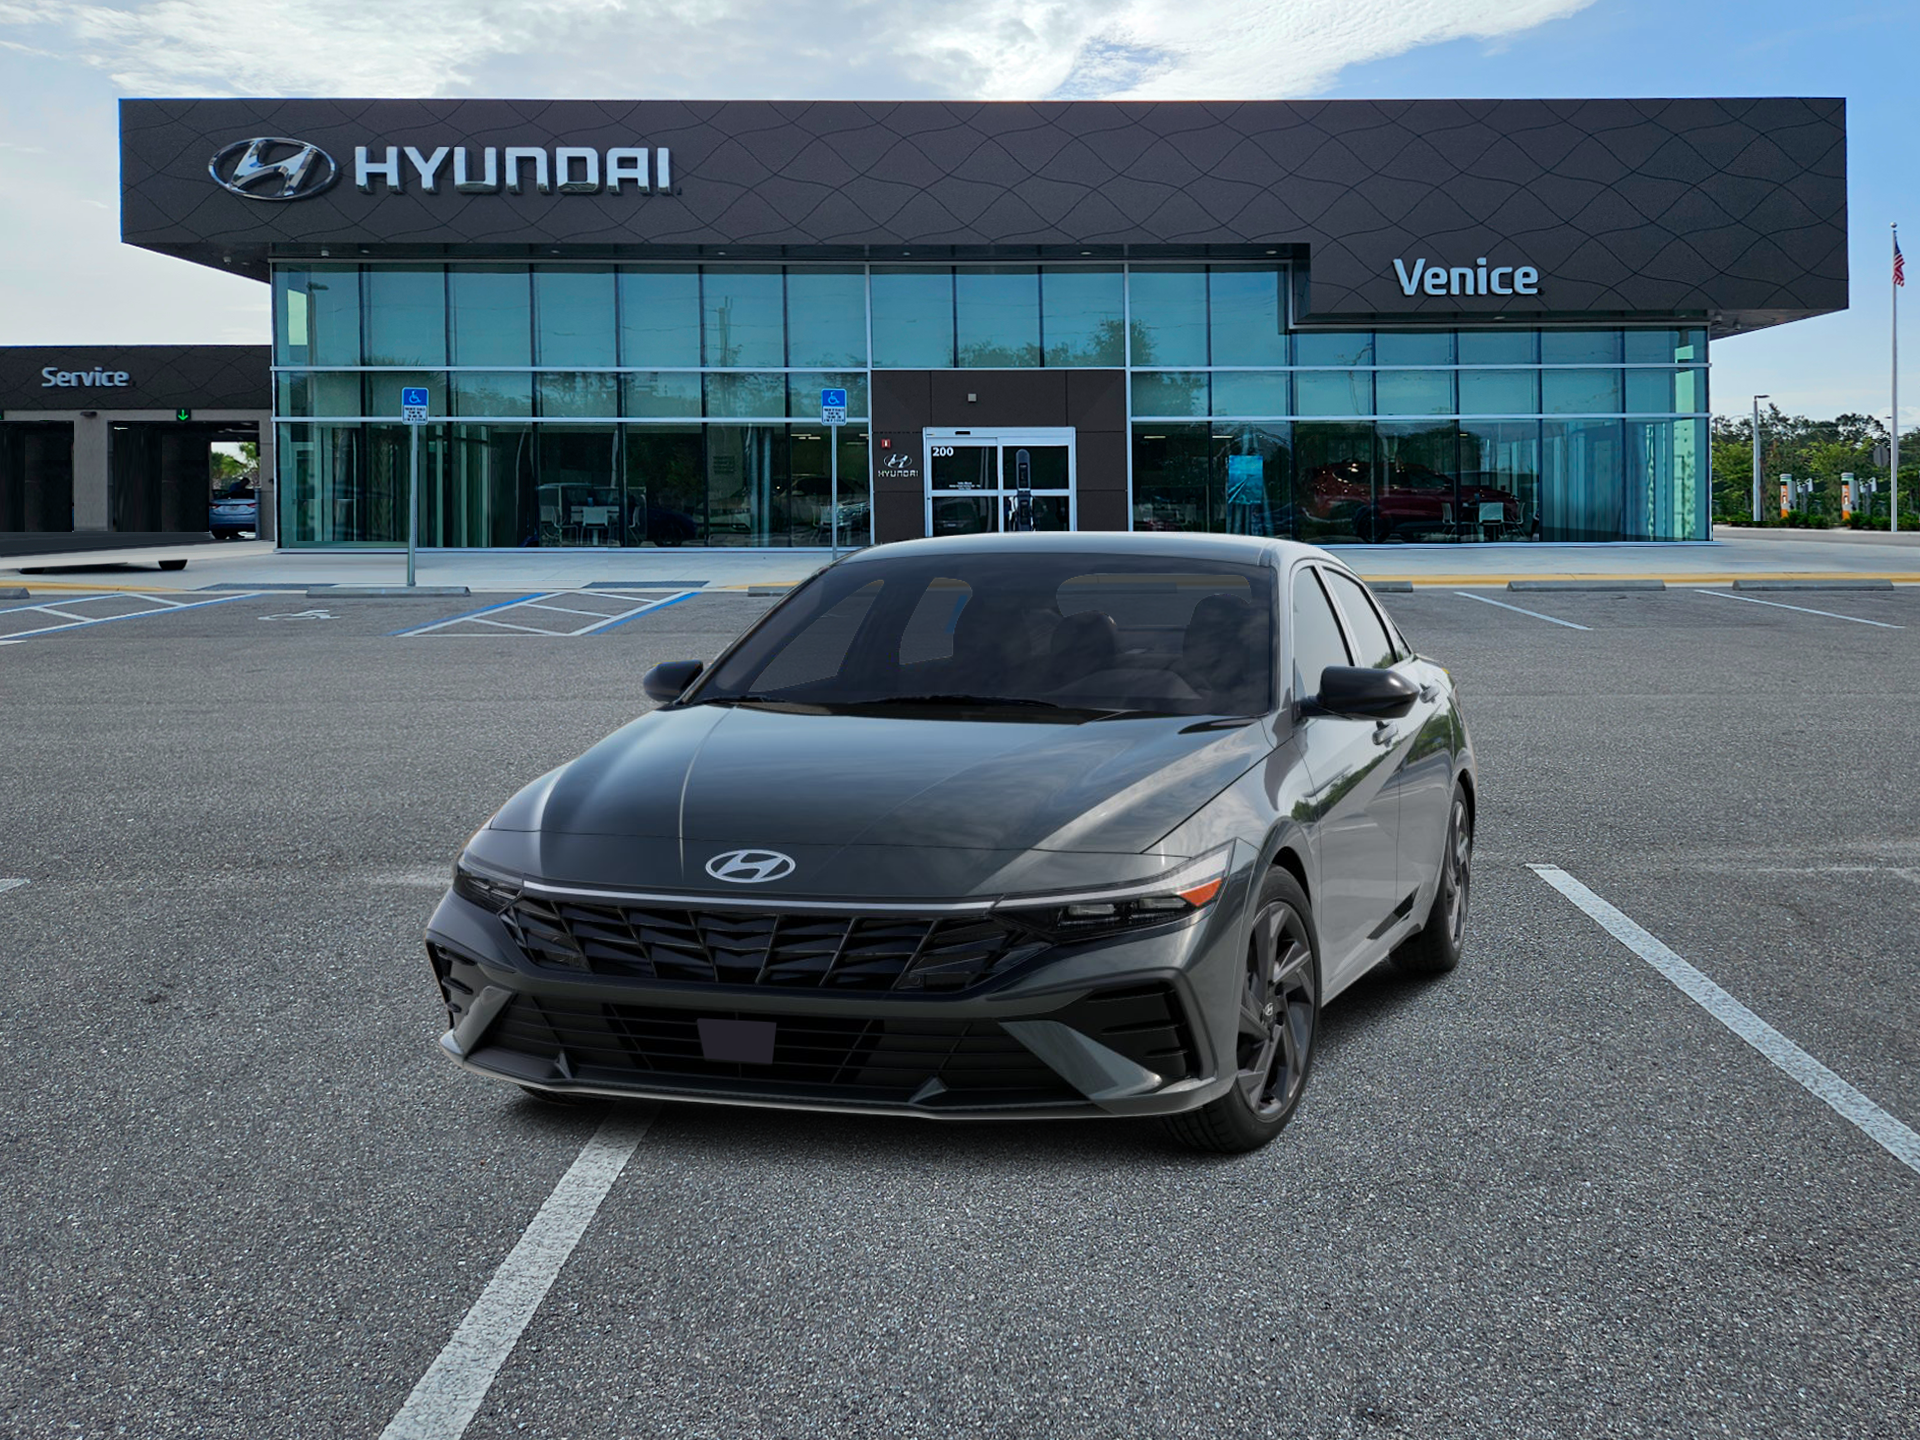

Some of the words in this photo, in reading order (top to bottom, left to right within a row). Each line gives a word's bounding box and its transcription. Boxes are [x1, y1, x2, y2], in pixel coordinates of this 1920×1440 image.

[354, 146, 671, 194] HYUNDAI
[1393, 257, 1539, 295] Venice
[41, 366, 130, 387] Service
[932, 446, 954, 457] 200
[877, 470, 919, 478] HYUNDAI
